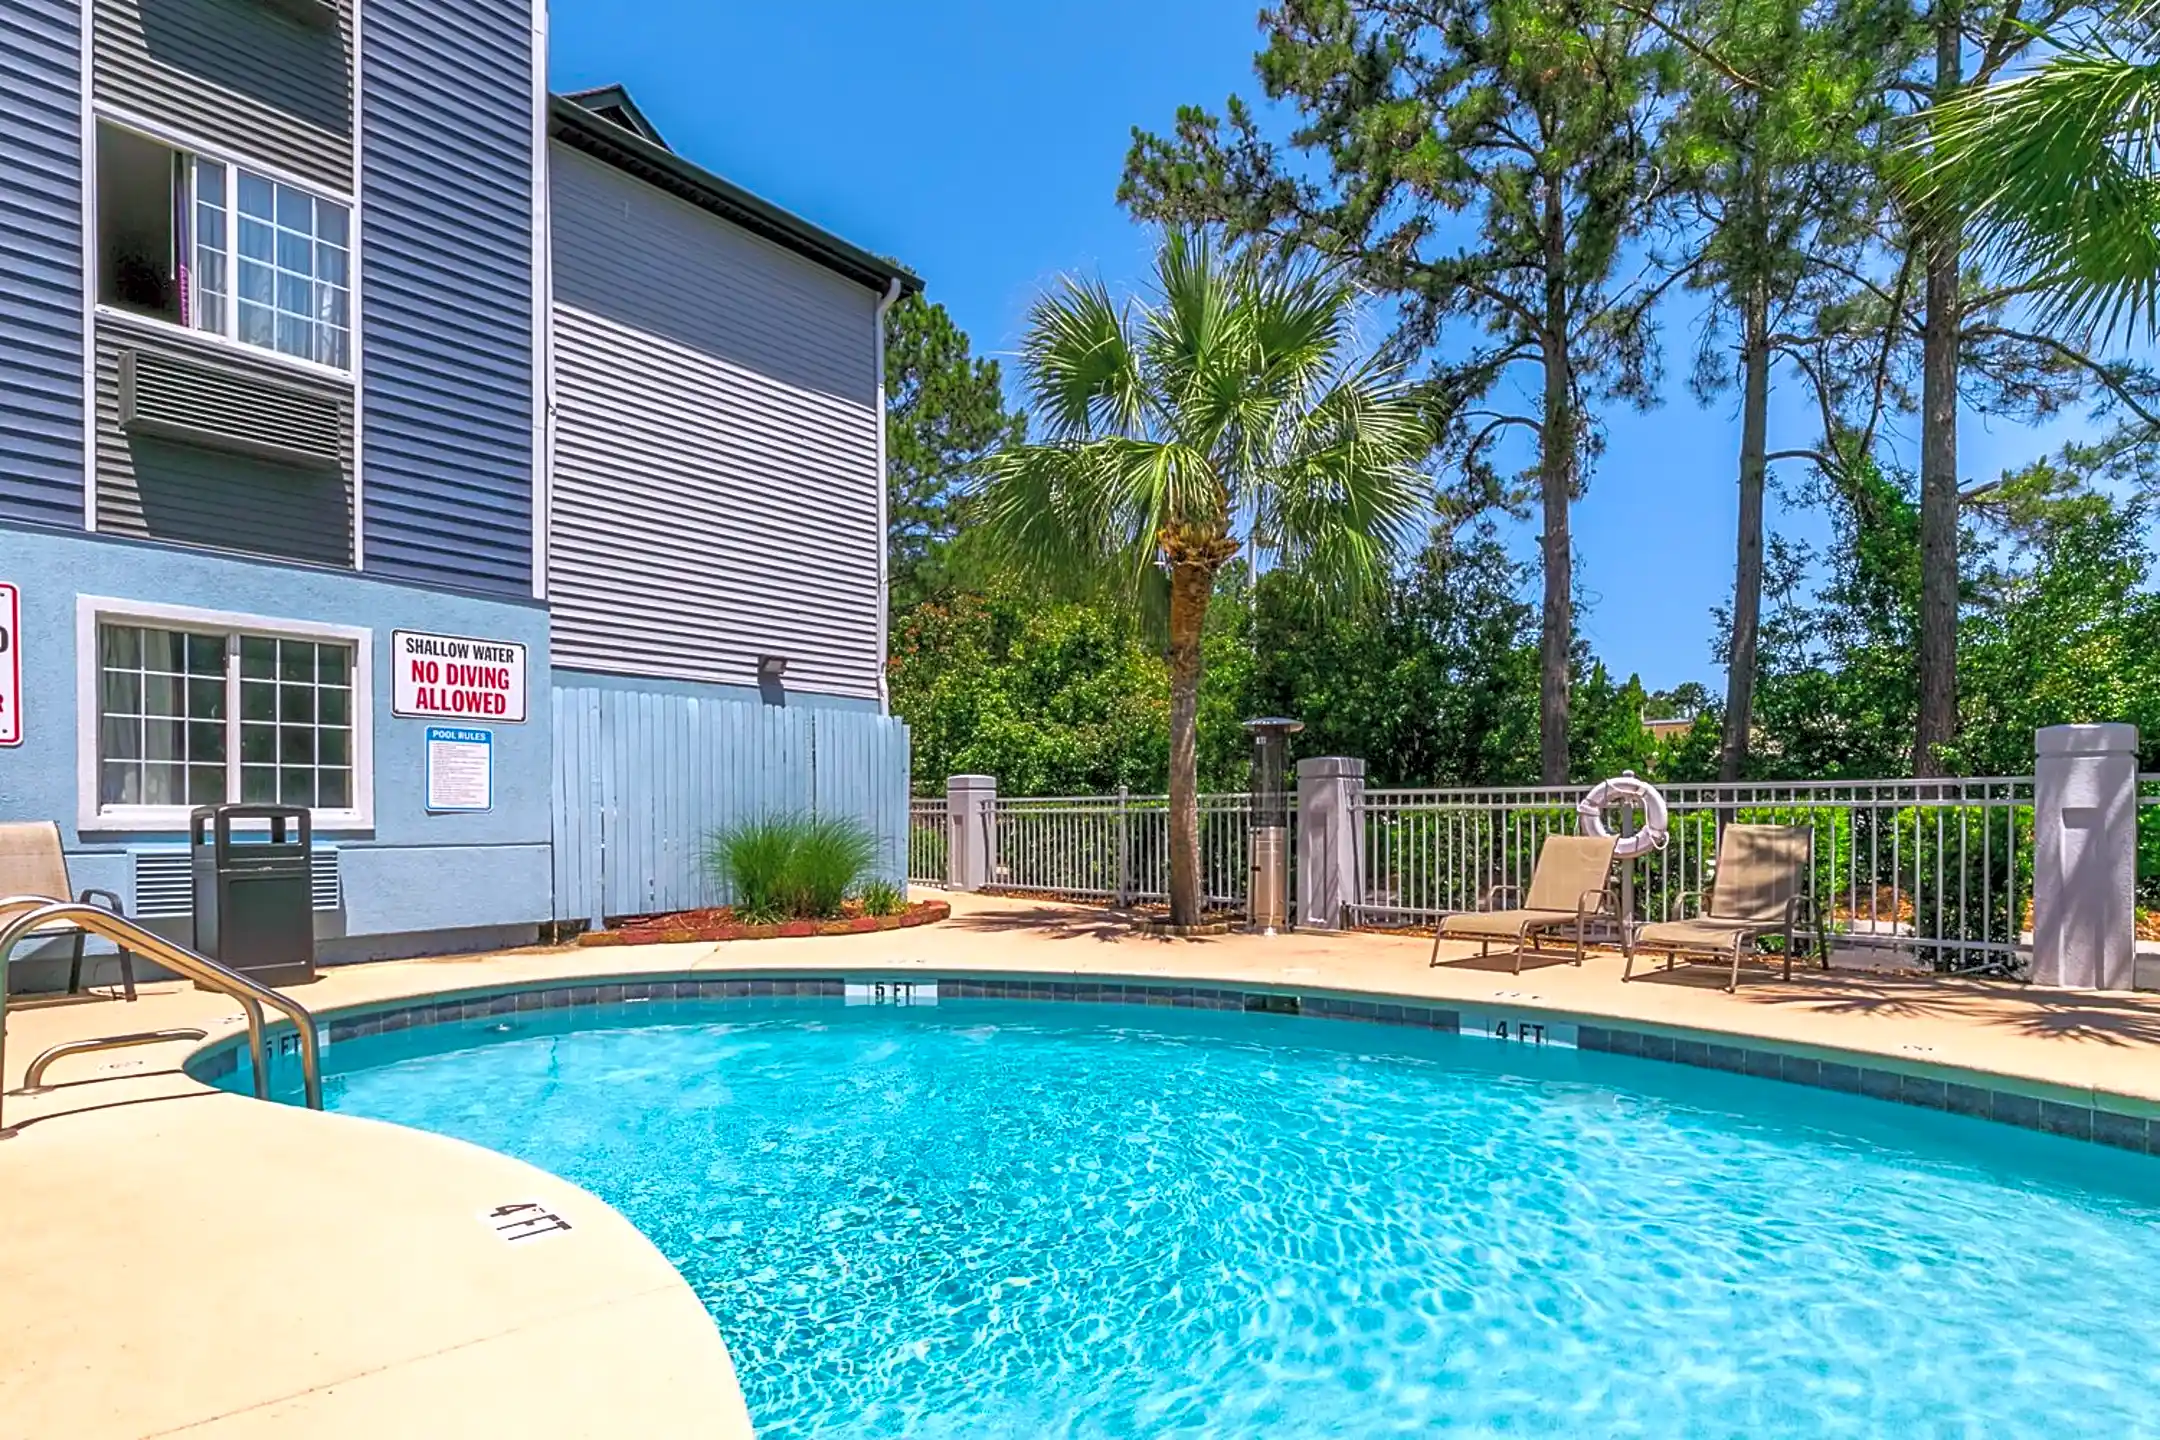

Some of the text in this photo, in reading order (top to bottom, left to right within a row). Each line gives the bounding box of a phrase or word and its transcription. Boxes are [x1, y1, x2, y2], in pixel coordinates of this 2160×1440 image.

[405, 637, 515, 663] SHALLOW WATER
[411, 660, 510, 690] NO DIVING
[415, 687, 507, 715] ALLOWED
[432, 729, 487, 741] POOL RULES
[875, 981, 913, 998] 5 FT
[281, 1032, 302, 1056] FT
[1496, 1021, 1545, 1043] 4 FT
